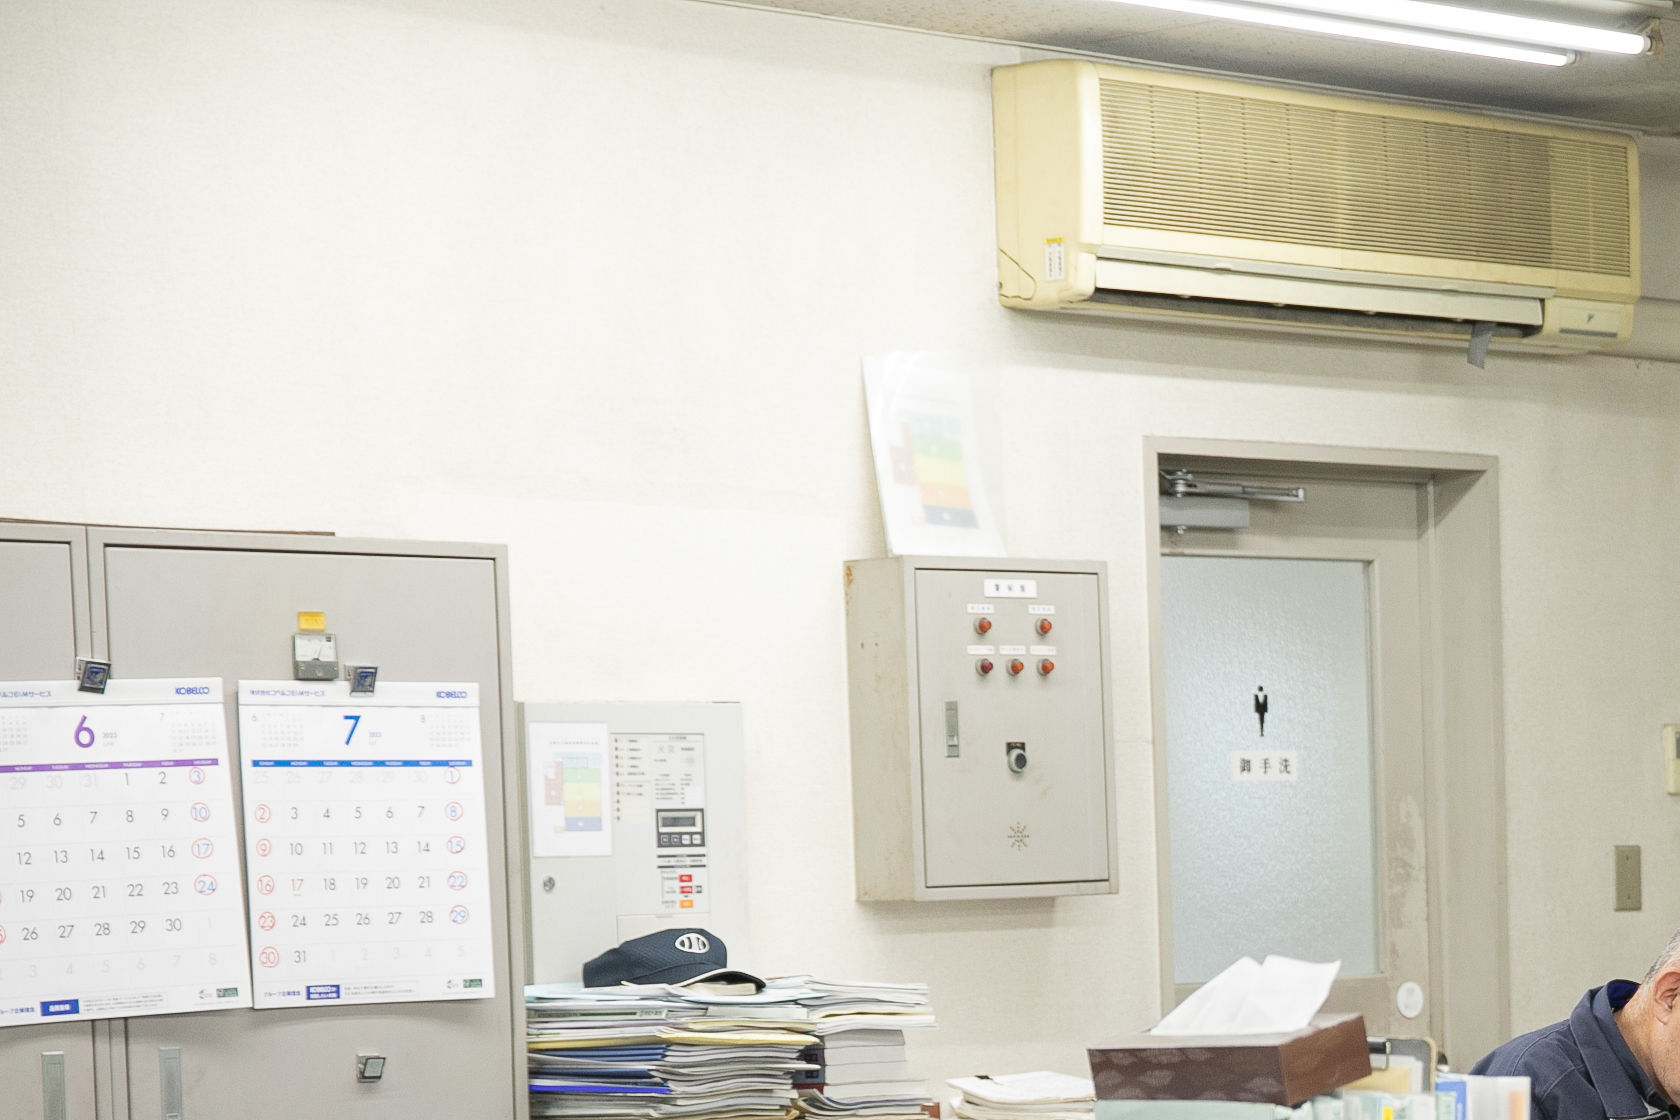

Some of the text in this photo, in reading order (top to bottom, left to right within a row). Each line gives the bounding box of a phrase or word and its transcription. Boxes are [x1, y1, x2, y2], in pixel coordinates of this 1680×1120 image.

[175, 687, 209, 695] KOBELCO
[436, 691, 467, 699] KOBELCO
[74, 715, 95, 748] 6
[343, 715, 361, 746] 7
[1240, 757, 1290, 774] 御手洗
[21, 880, 215, 902] 19 20 21 22 23 24
[260, 910, 466, 928] 23 24 25 26 27 28 29
